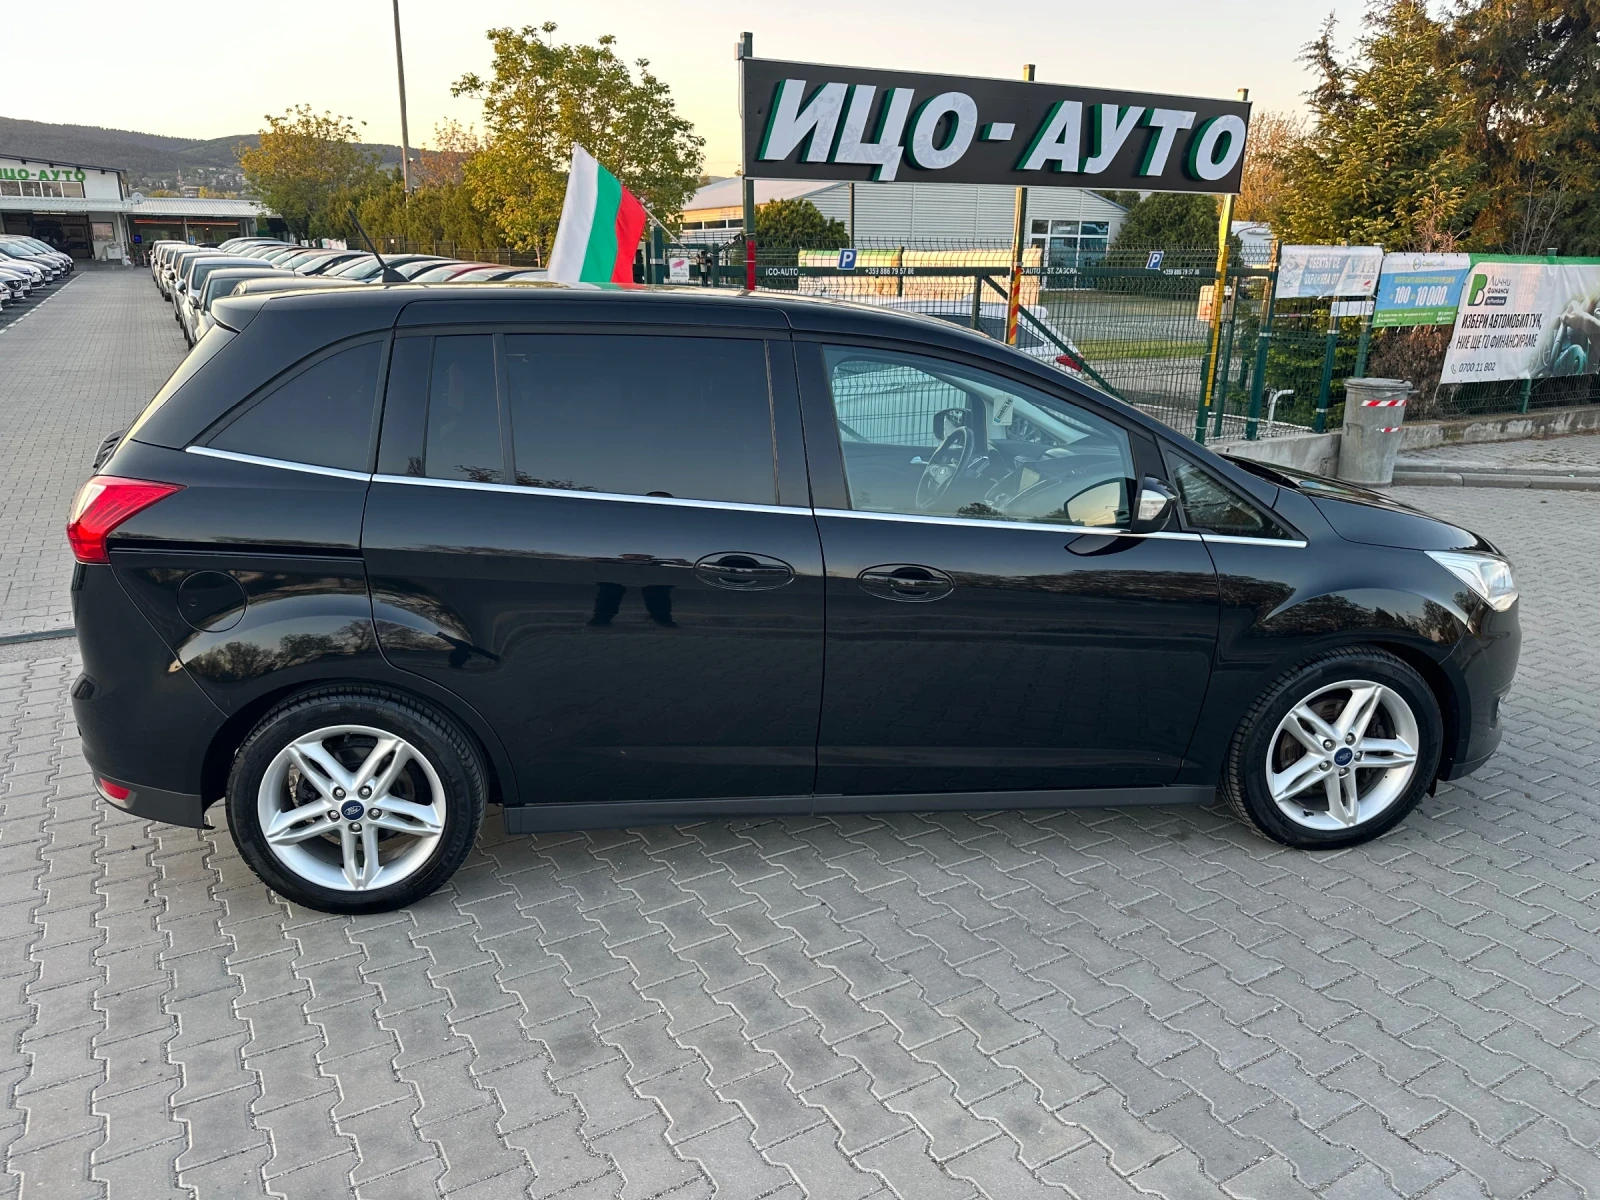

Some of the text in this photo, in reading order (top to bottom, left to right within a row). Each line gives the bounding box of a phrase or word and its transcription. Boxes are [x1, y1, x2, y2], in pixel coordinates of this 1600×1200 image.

[758, 79, 1246, 181] ИЦО-АУТО
[842, 251, 854, 267] P
[1150, 254, 1160, 267] P
[1394, 285, 1411, 304] 100
[1461, 313, 1489, 329] ИЗБЕРИ
[1488, 313, 1530, 329] АВТОМОБИЛ
[1456, 333, 1538, 351] НИЕ ЩЕ ГО ФИНАНСИРАМЕ
[1458, 362, 1496, 372] 0700 11 802
